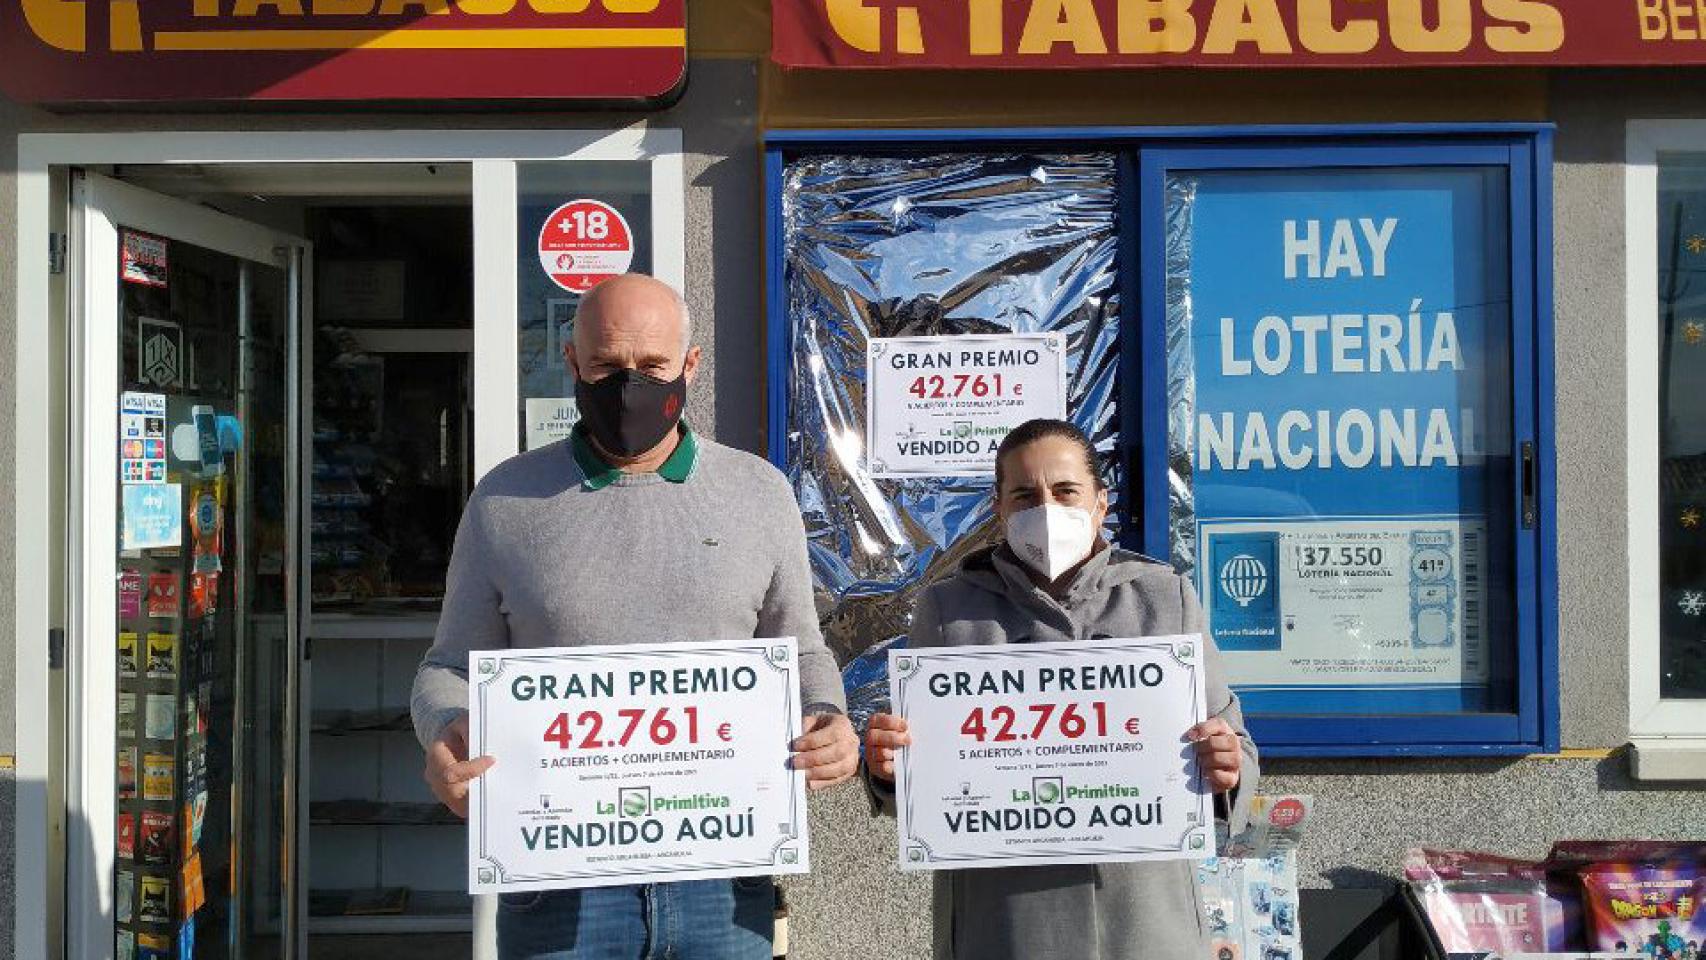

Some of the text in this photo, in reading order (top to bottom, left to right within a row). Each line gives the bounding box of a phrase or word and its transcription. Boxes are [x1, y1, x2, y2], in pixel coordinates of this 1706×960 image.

[557, 211, 609, 240] +18
[1284, 218, 1398, 279] HAY
[1220, 299, 1465, 376] LOTERÍA
[891, 350, 1039, 370] GRAN PREMIO
[909, 374, 1002, 399] 42.761
[897, 440, 980, 456] VENDIDO
[1303, 547, 1382, 566] 37.550
[511, 666, 757, 701] GRAN PREMIO
[928, 662, 1163, 698] GRAN PREMIO
[543, 706, 732, 750] 42.761 €
[960, 702, 1140, 742] 42.761 €
[541, 758, 548, 769] 5
[551, 755, 609, 768] ACIERTOS
[622, 748, 735, 764] COMPLEMENTARIO
[959, 750, 966, 760] 5
[969, 747, 1023, 759] ACIERTOS
[1035, 742, 1144, 756] COMPLEMENTARIO
[597, 793, 730, 815] La Primitiva
[1012, 783, 1140, 802] La Primitiva
[520, 806, 755, 851] VENDIDO AQUÍ
[943, 796, 1163, 834] VENDIDO AQUÍ
